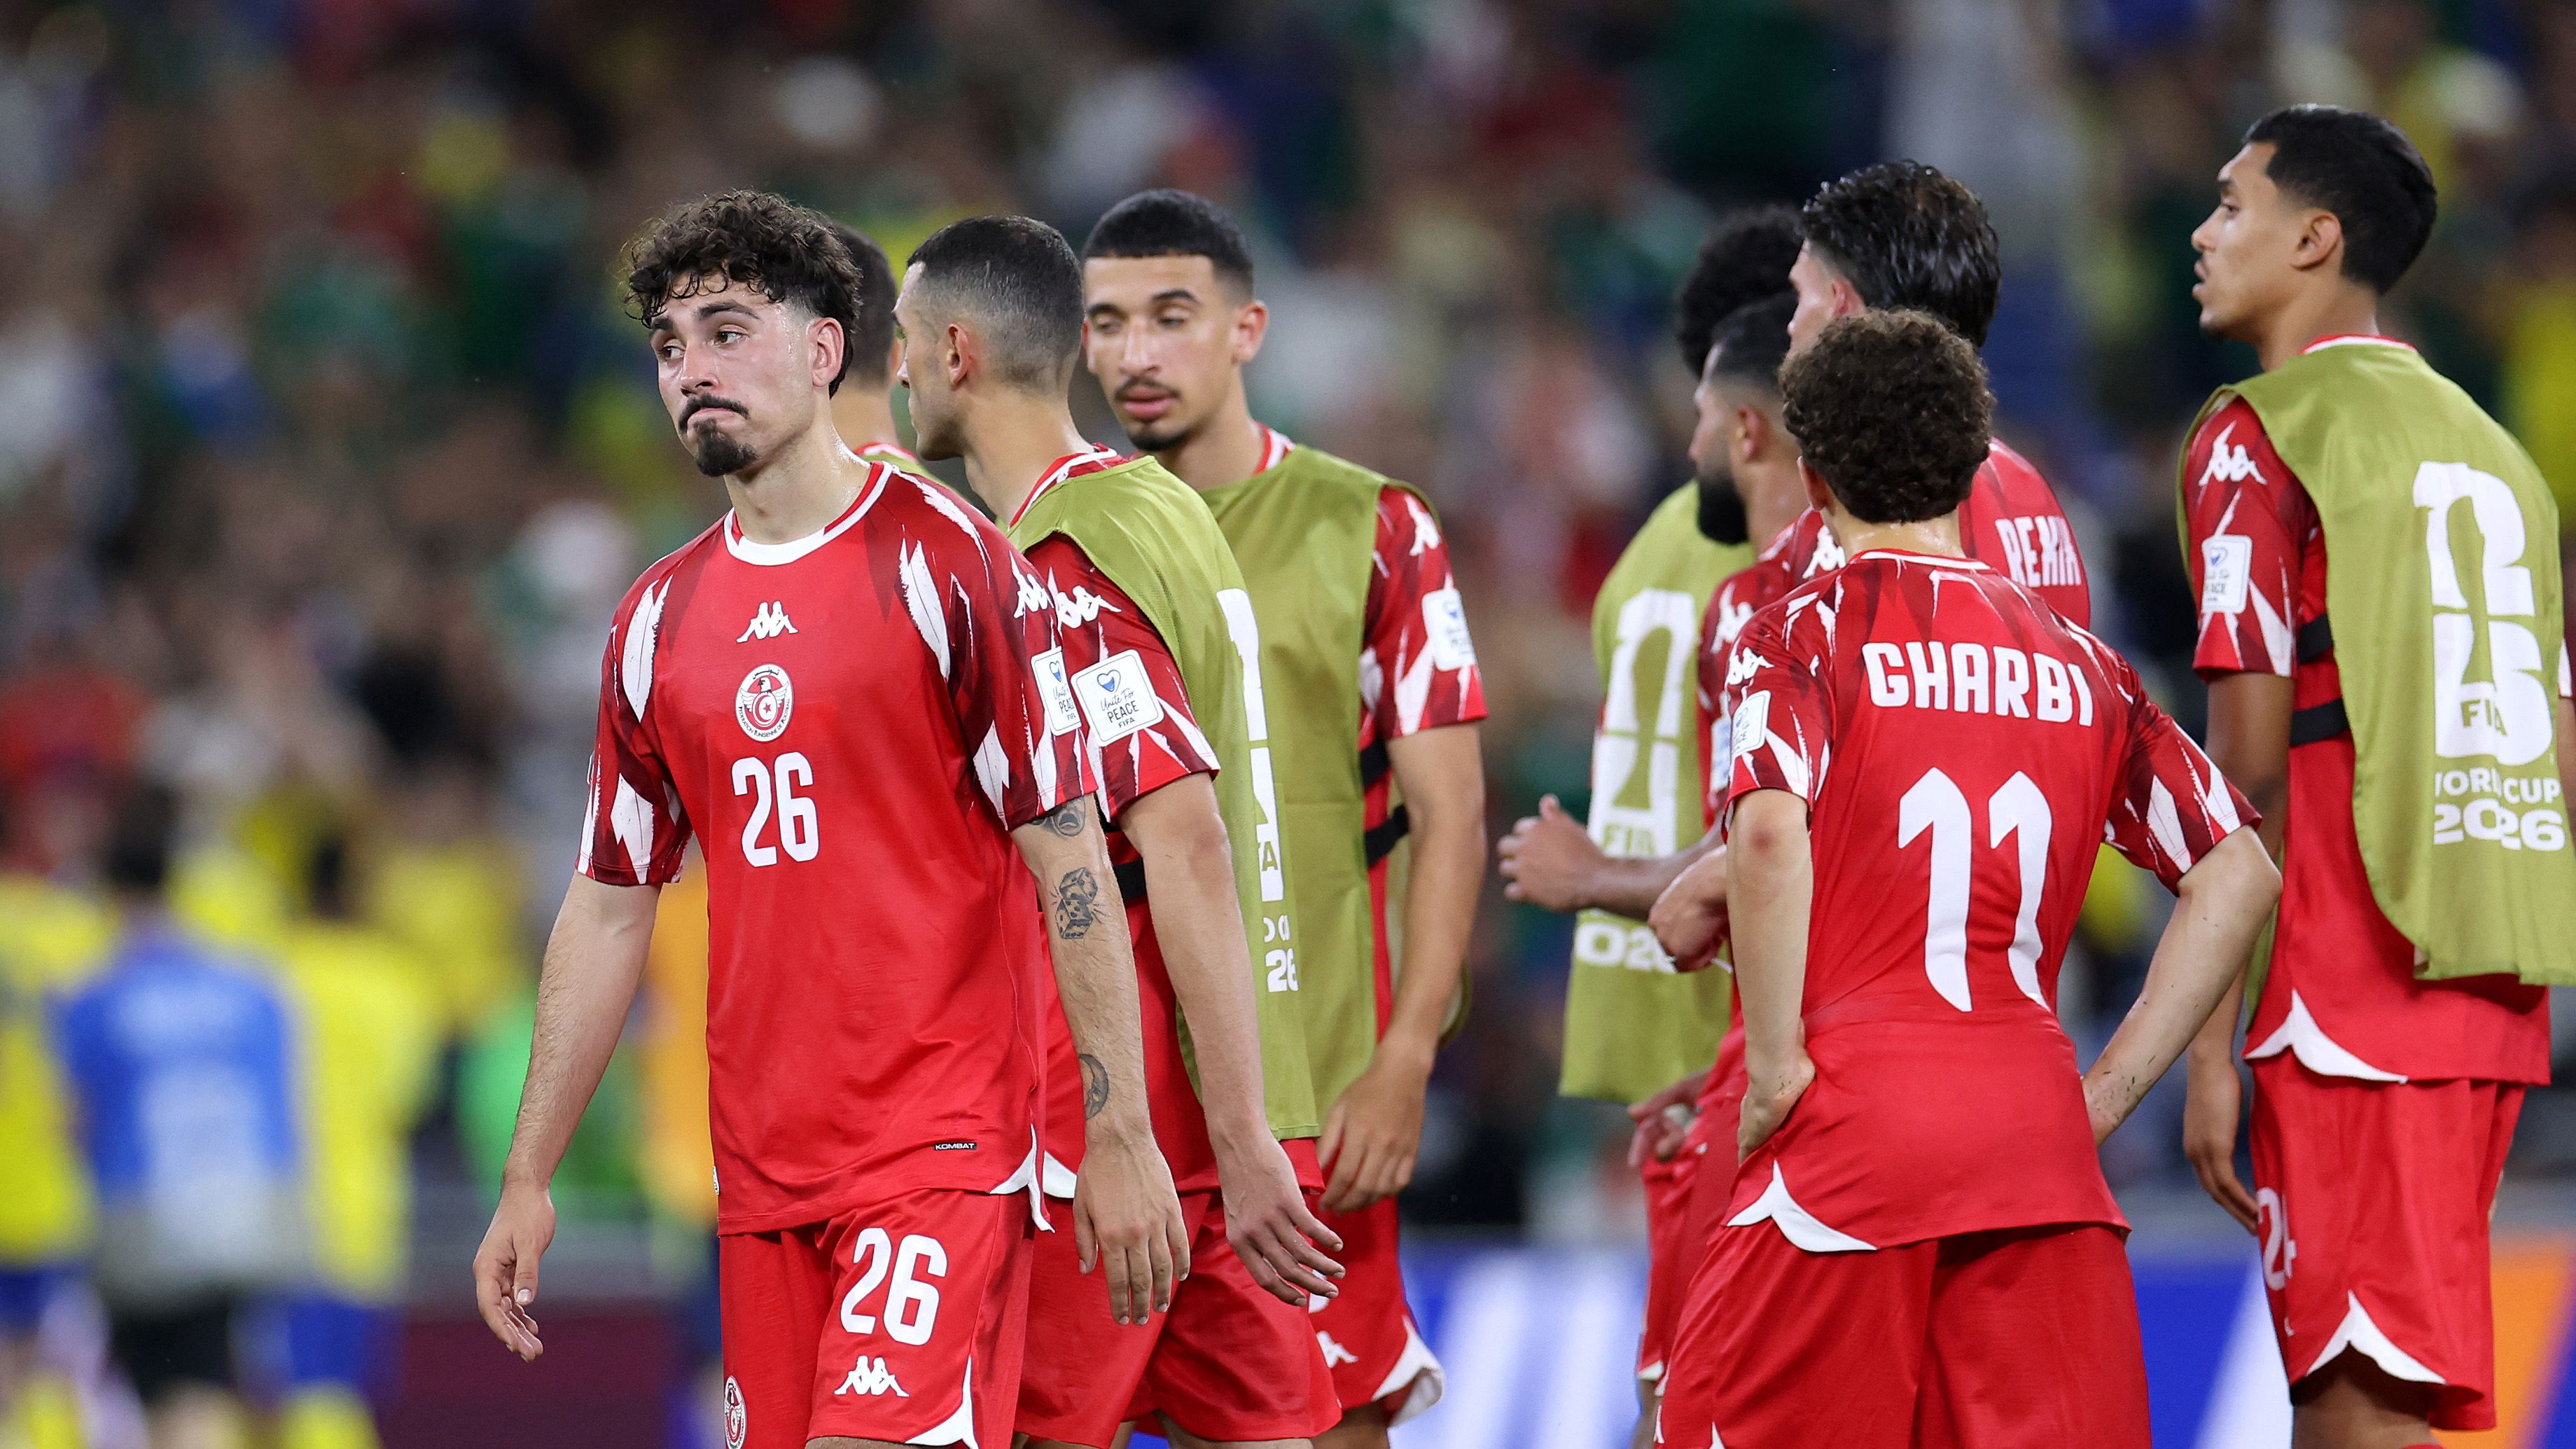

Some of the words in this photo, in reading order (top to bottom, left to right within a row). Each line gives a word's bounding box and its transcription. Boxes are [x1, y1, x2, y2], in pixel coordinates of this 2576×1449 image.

[1101, 695, 1122, 712] Unite
[1120, 688, 1134, 702] For
[1861, 640, 2094, 727] GHARBI
[1106, 700, 1140, 723] PEACE
[1118, 717, 1136, 728] FIFA
[732, 751, 819, 867] 26
[2502, 777, 2562, 804] CUP
[2433, 798, 2566, 852] 2026
[1898, 767, 2052, 1013] 11
[840, 1227, 948, 1346] 26
